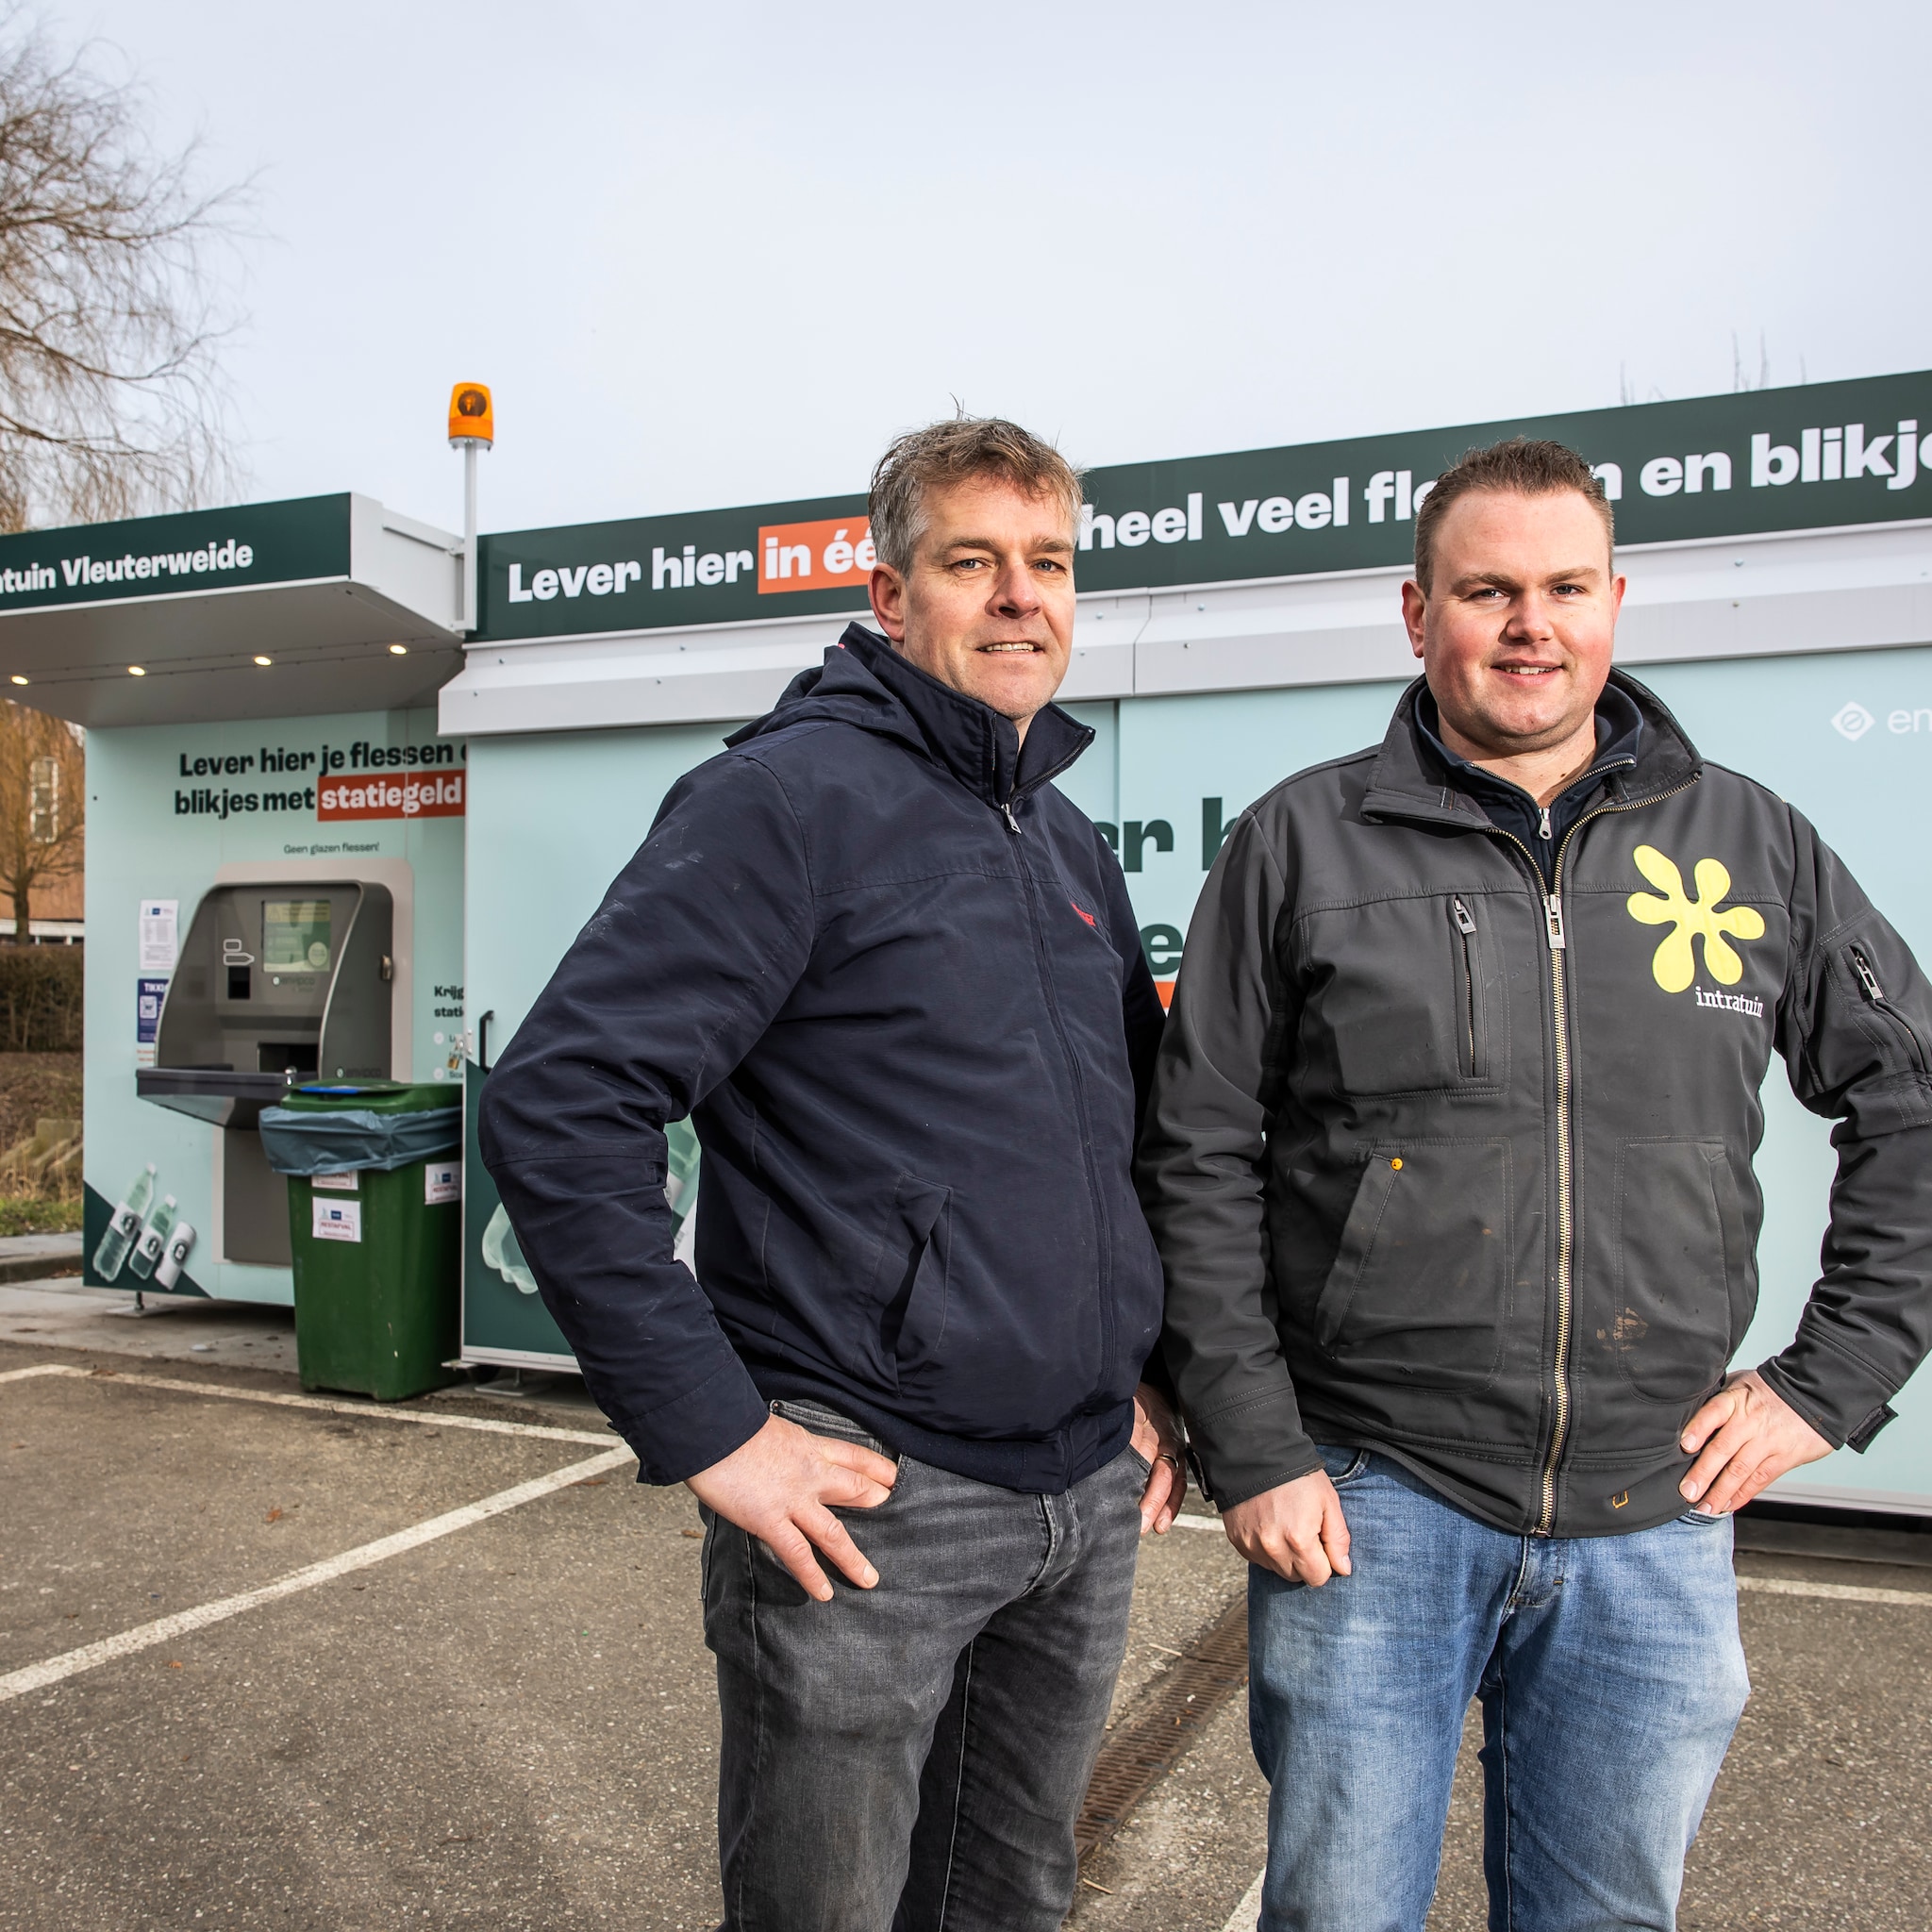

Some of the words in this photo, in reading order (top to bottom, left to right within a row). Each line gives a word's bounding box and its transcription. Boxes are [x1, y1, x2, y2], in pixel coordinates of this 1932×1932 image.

[508, 560, 642, 604] Lever
[652, 544, 754, 591] hier
[765, 537, 811, 580] in
[1078, 491, 1203, 552] heel
[1217, 475, 1350, 538] veel
[1640, 451, 1733, 498] en
[0, 561, 58, 595] tuin
[60, 538, 255, 587] Vleuterweide
[179, 752, 254, 777] Lever
[260, 746, 316, 773] hier
[319, 744, 345, 777] je
[350, 741, 455, 768] flessen
[175, 787, 259, 820] blikjes
[263, 786, 315, 811] met
[321, 776, 462, 814] statiegeld
[283, 842, 308, 855] Geen
[310, 842, 341, 857] glazen
[341, 841, 379, 854] flessen!
[434, 1006, 464, 1018] stati
[1695, 986, 1763, 1018] intratuin
